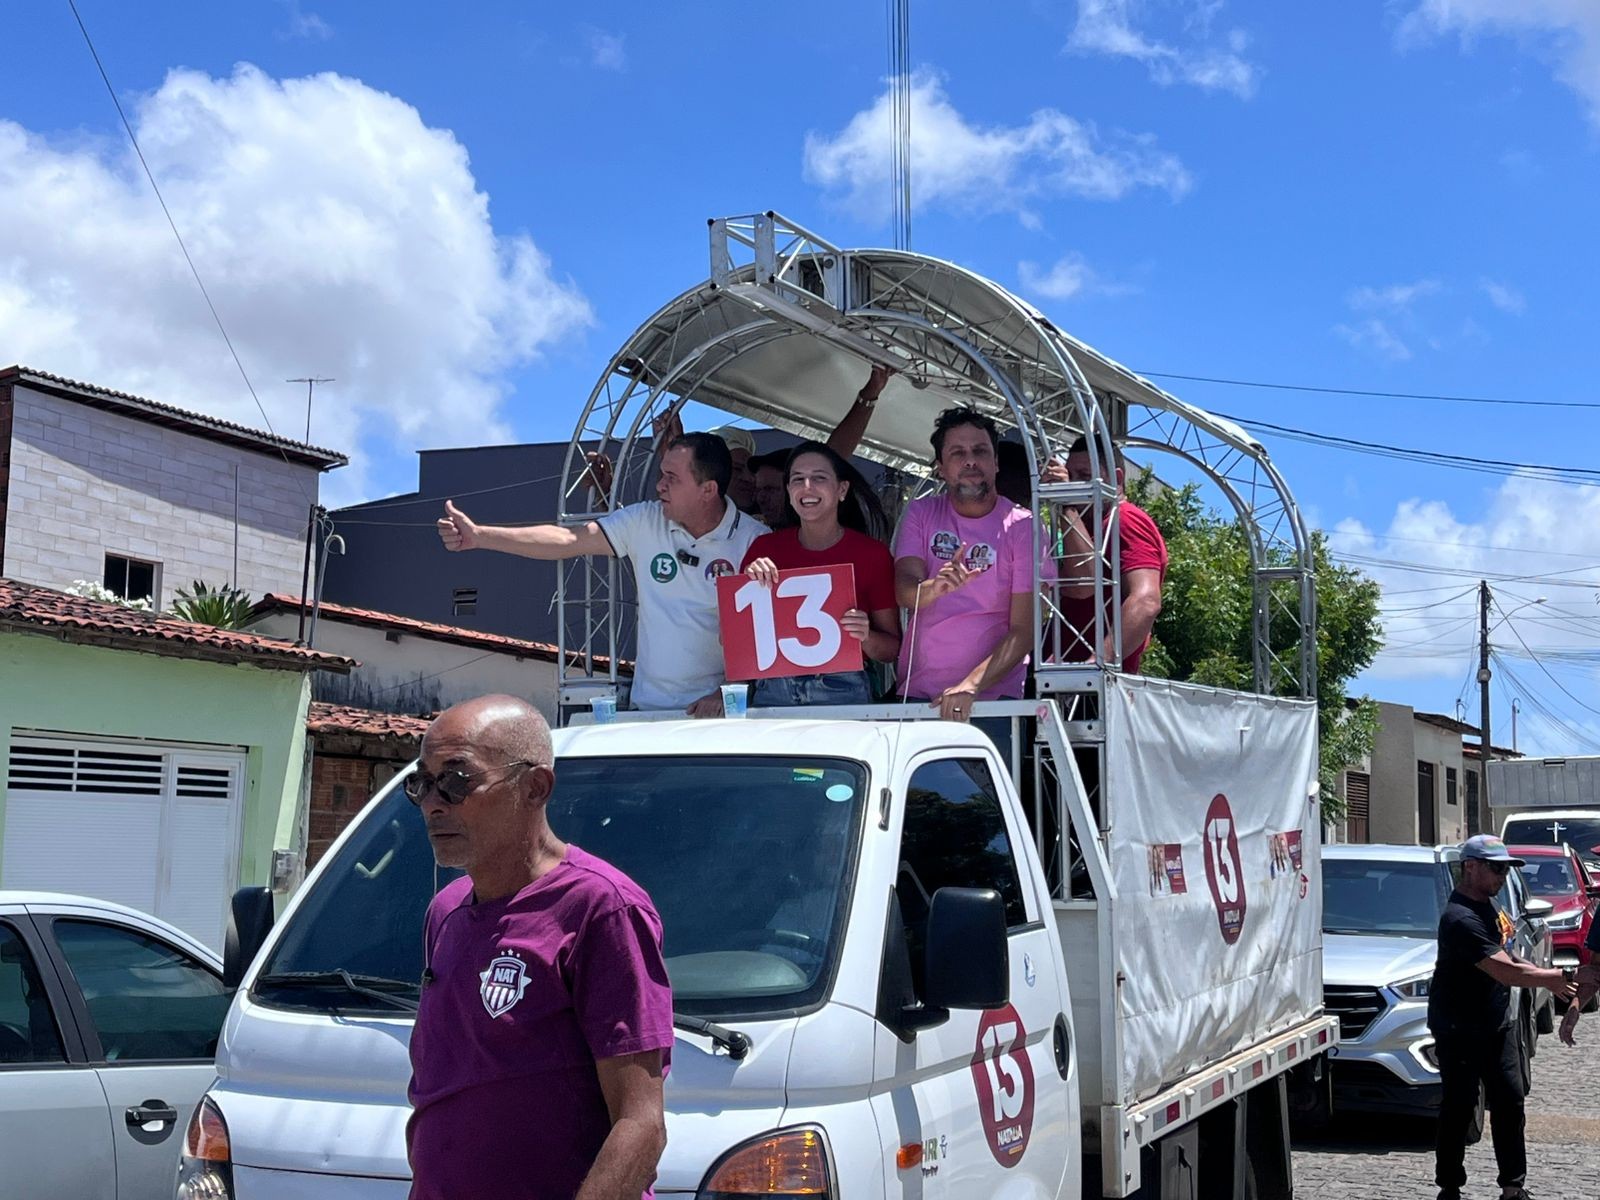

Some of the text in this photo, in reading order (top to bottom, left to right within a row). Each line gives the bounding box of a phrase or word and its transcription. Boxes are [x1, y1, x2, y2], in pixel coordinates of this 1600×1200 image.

[656, 558, 673, 575] 13
[734, 573, 842, 672] 13
[1207, 818, 1238, 903] 13
[494, 967, 517, 984] NAT
[981, 1021, 1024, 1122] 13
